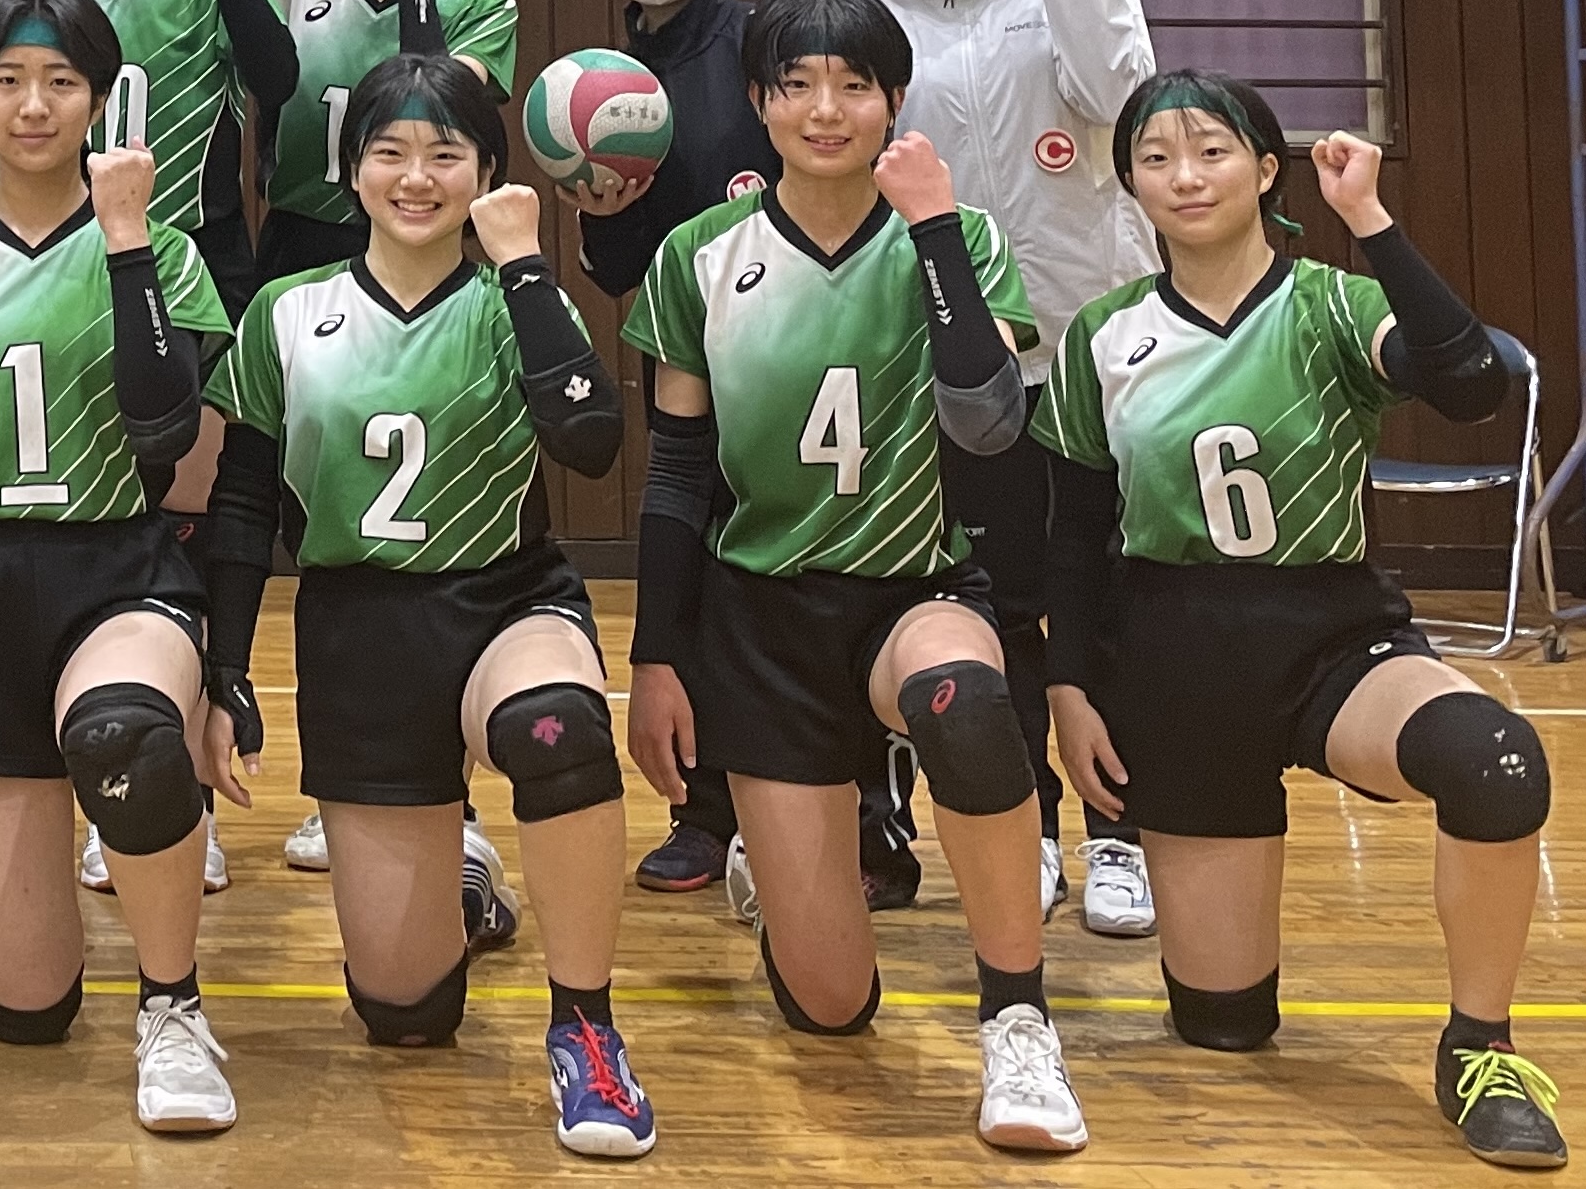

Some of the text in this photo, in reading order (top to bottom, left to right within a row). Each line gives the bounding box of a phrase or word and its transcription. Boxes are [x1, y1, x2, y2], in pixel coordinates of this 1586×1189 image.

[0, 344, 48, 473] 1
[799, 367, 869, 496] 4
[360, 412, 428, 542] 2
[1193, 424, 1278, 559] 6
